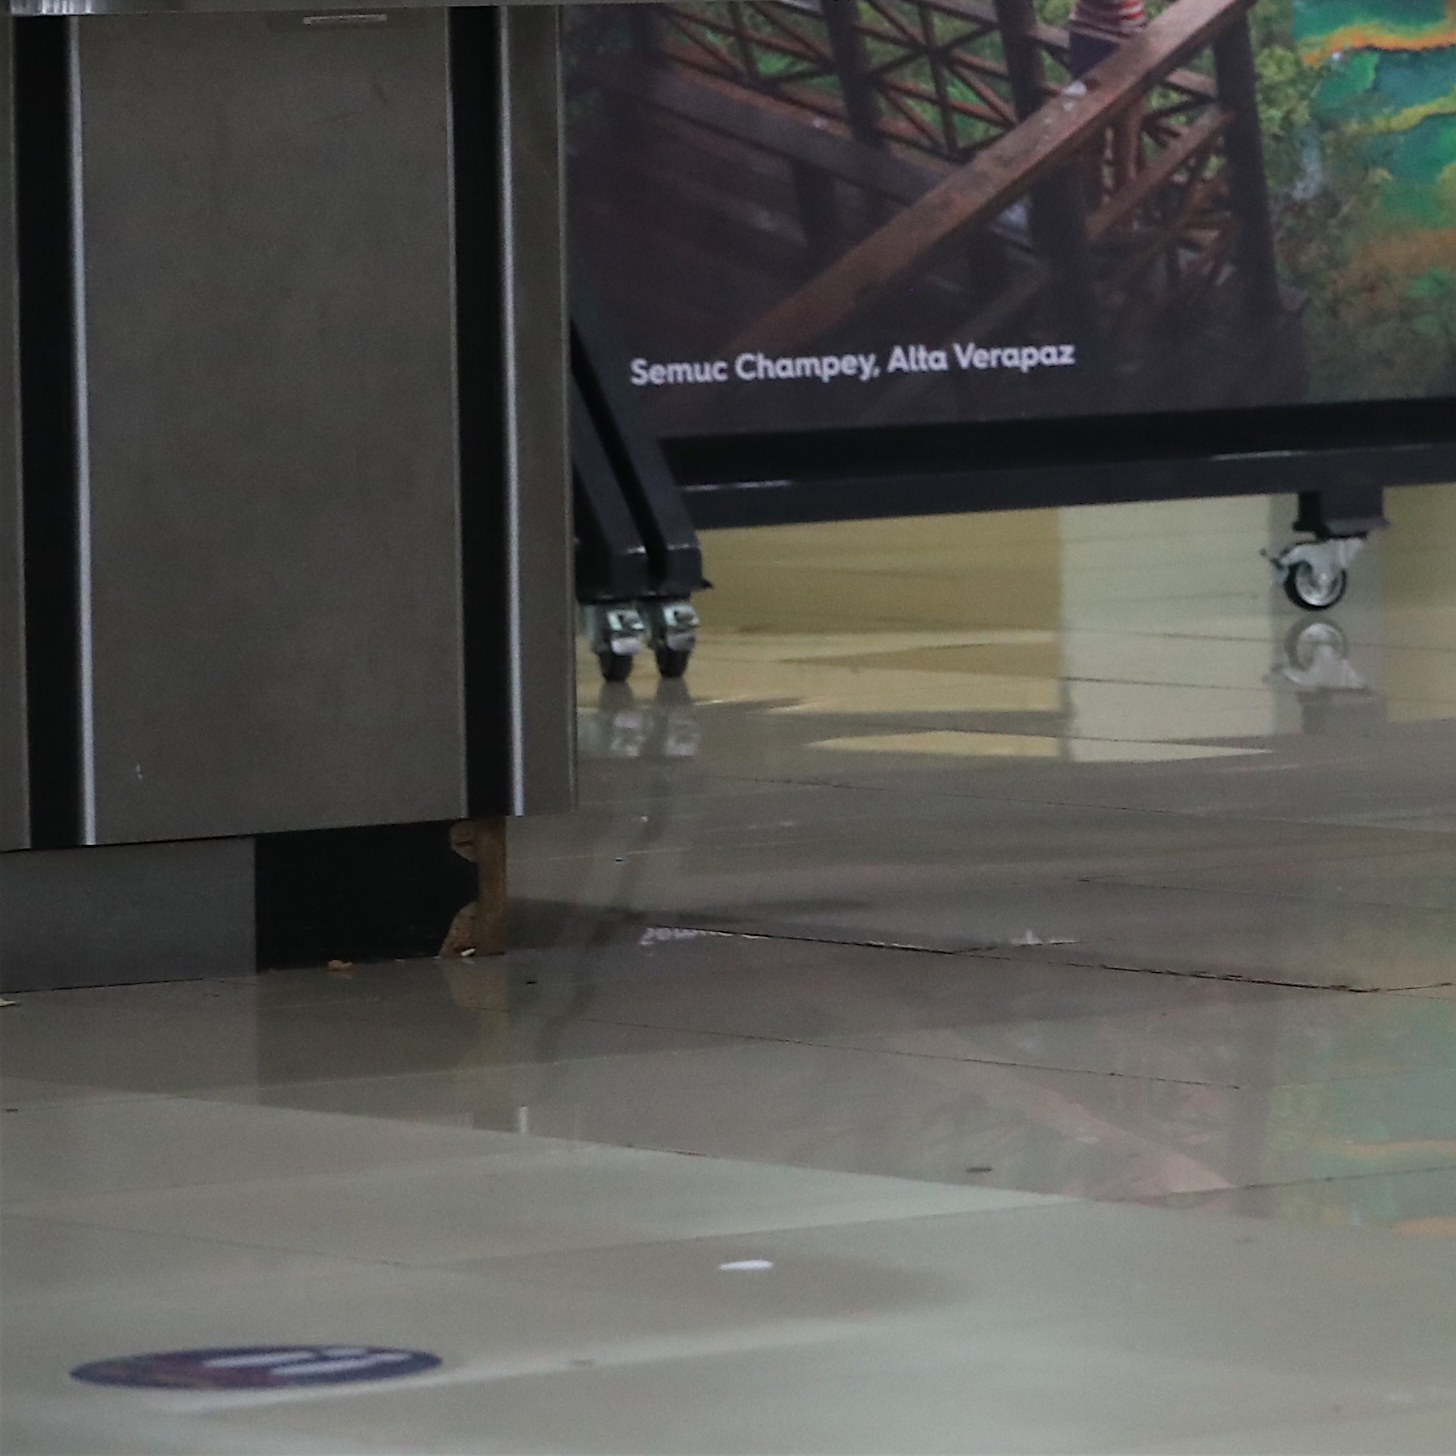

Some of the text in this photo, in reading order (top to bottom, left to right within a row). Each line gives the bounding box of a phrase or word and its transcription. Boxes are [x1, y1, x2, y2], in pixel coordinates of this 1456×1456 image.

[630, 342, 1076, 386] Semuc Champey, Alta Verapaz
